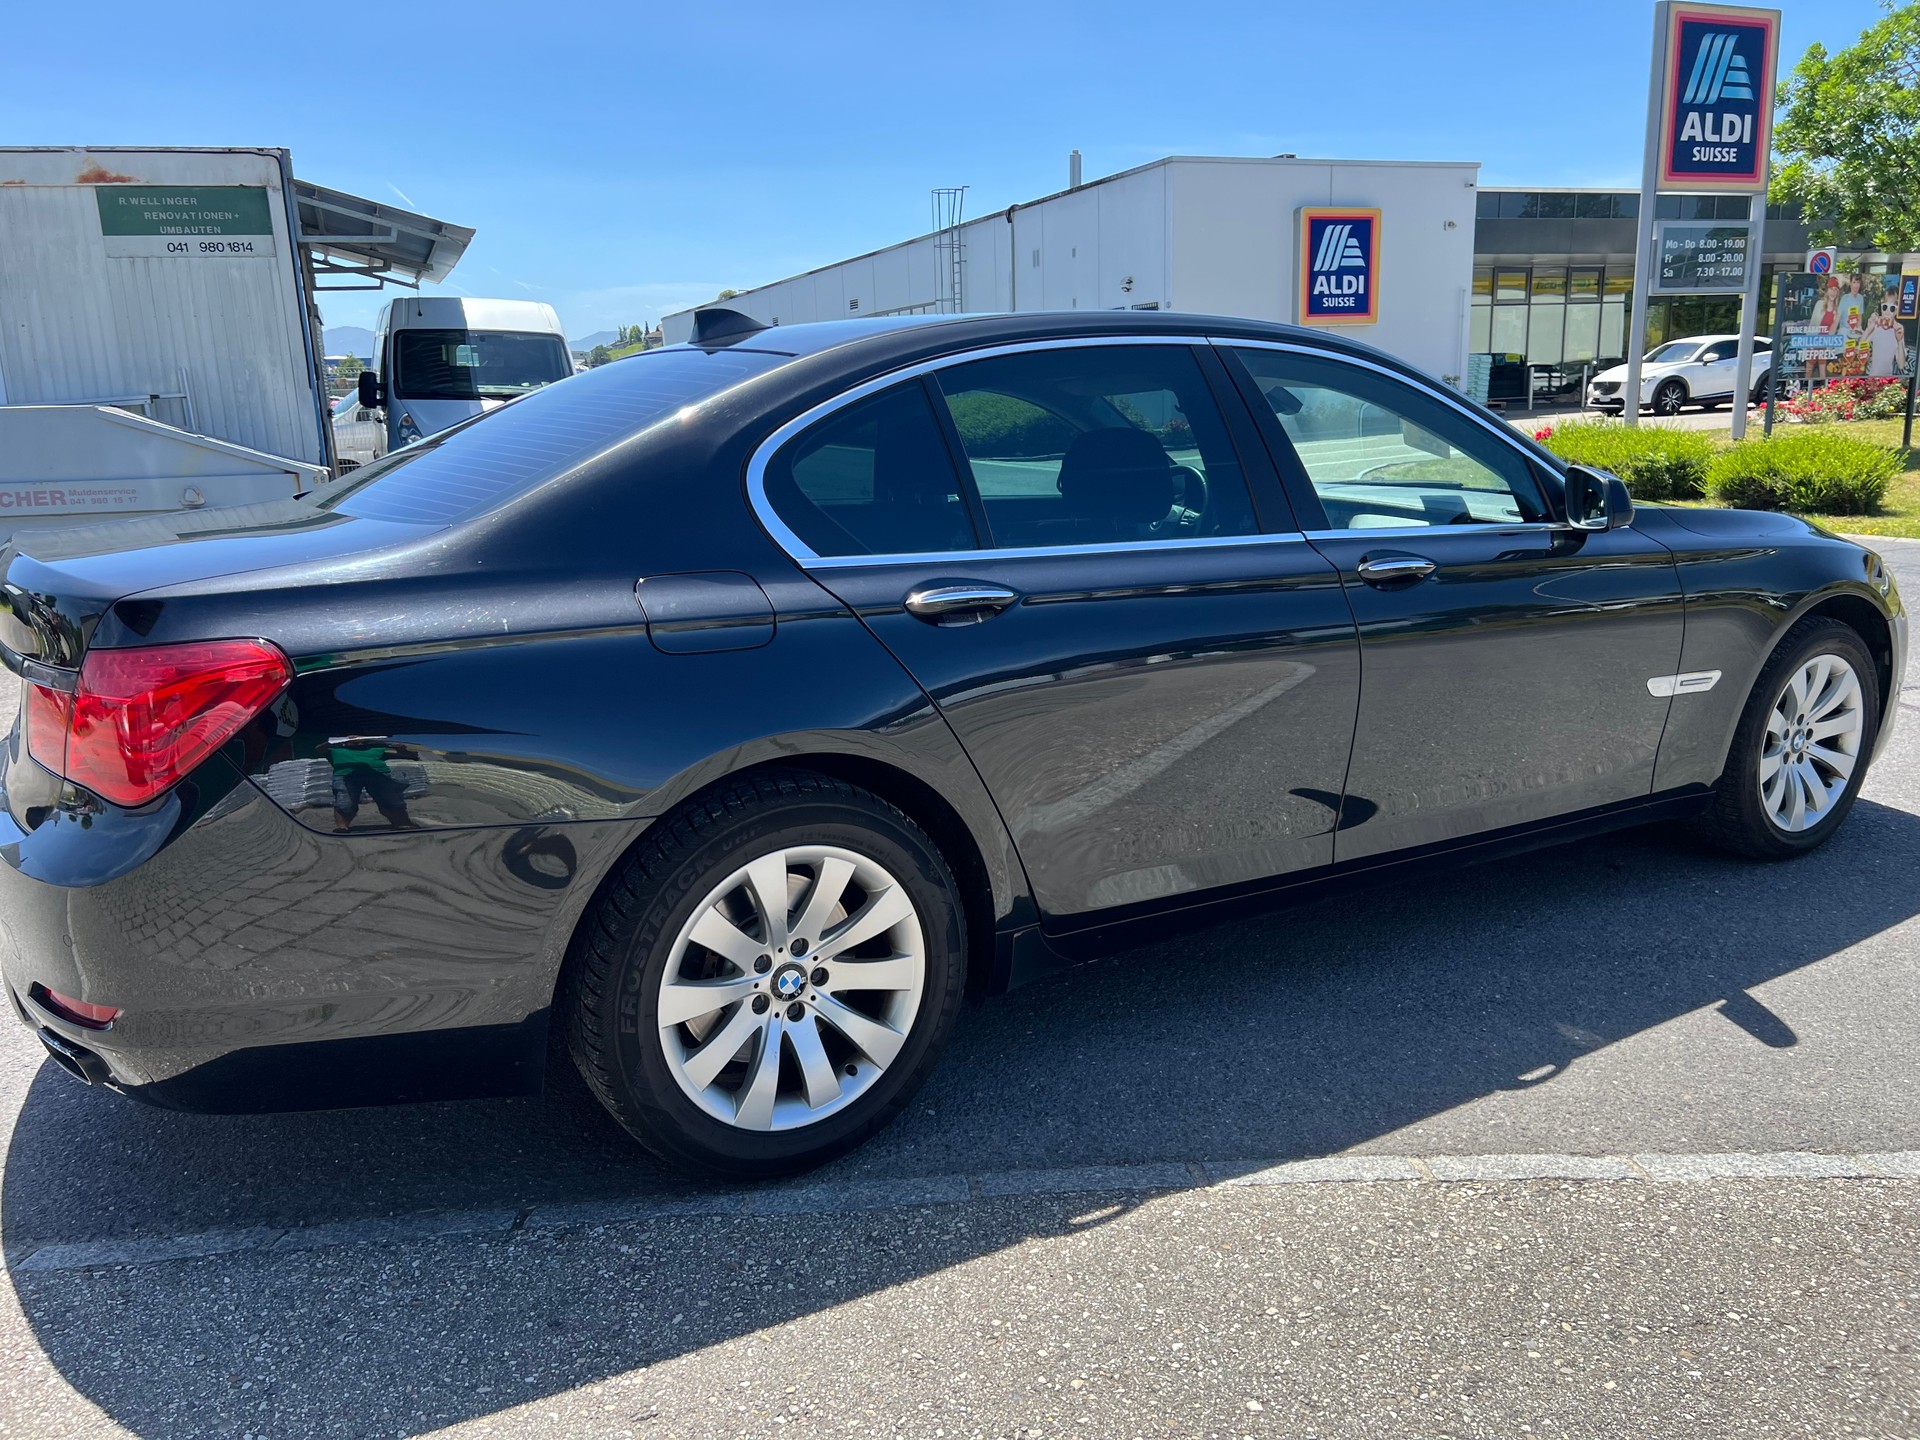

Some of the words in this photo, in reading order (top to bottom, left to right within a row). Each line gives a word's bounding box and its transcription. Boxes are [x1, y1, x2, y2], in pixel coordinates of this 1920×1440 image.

[1680, 111, 1752, 144] ALDI
[1692, 146, 1738, 163] SUISSE
[129, 197, 197, 205] WELLINGER
[144, 211, 232, 220] RENOVATIONEN
[160, 226, 221, 234] UMBAUTEN
[167, 242, 189, 252] 041
[199, 242, 224, 252] 980
[227, 242, 253, 252] 1814
[1666, 240, 1678, 249] Mo
[1685, 240, 1696, 249] Do
[1699, 240, 1717, 249] 8.00
[1724, 240, 1745, 248] 19.00
[1665, 254, 1673, 263] Fr
[1698, 254, 1716, 263] 8.00
[1722, 253, 1744, 262] 20.00
[1663, 268, 1674, 277] Sa
[1697, 268, 1714, 277] 7.30
[1721, 267, 1743, 276] 17.00
[1313, 275, 1364, 294] ALDI
[1322, 297, 1355, 307] SUISSE
[1792, 336, 1843, 346] GRILLGENUSS
[620, 850, 716, 1034] FROSTRACK
